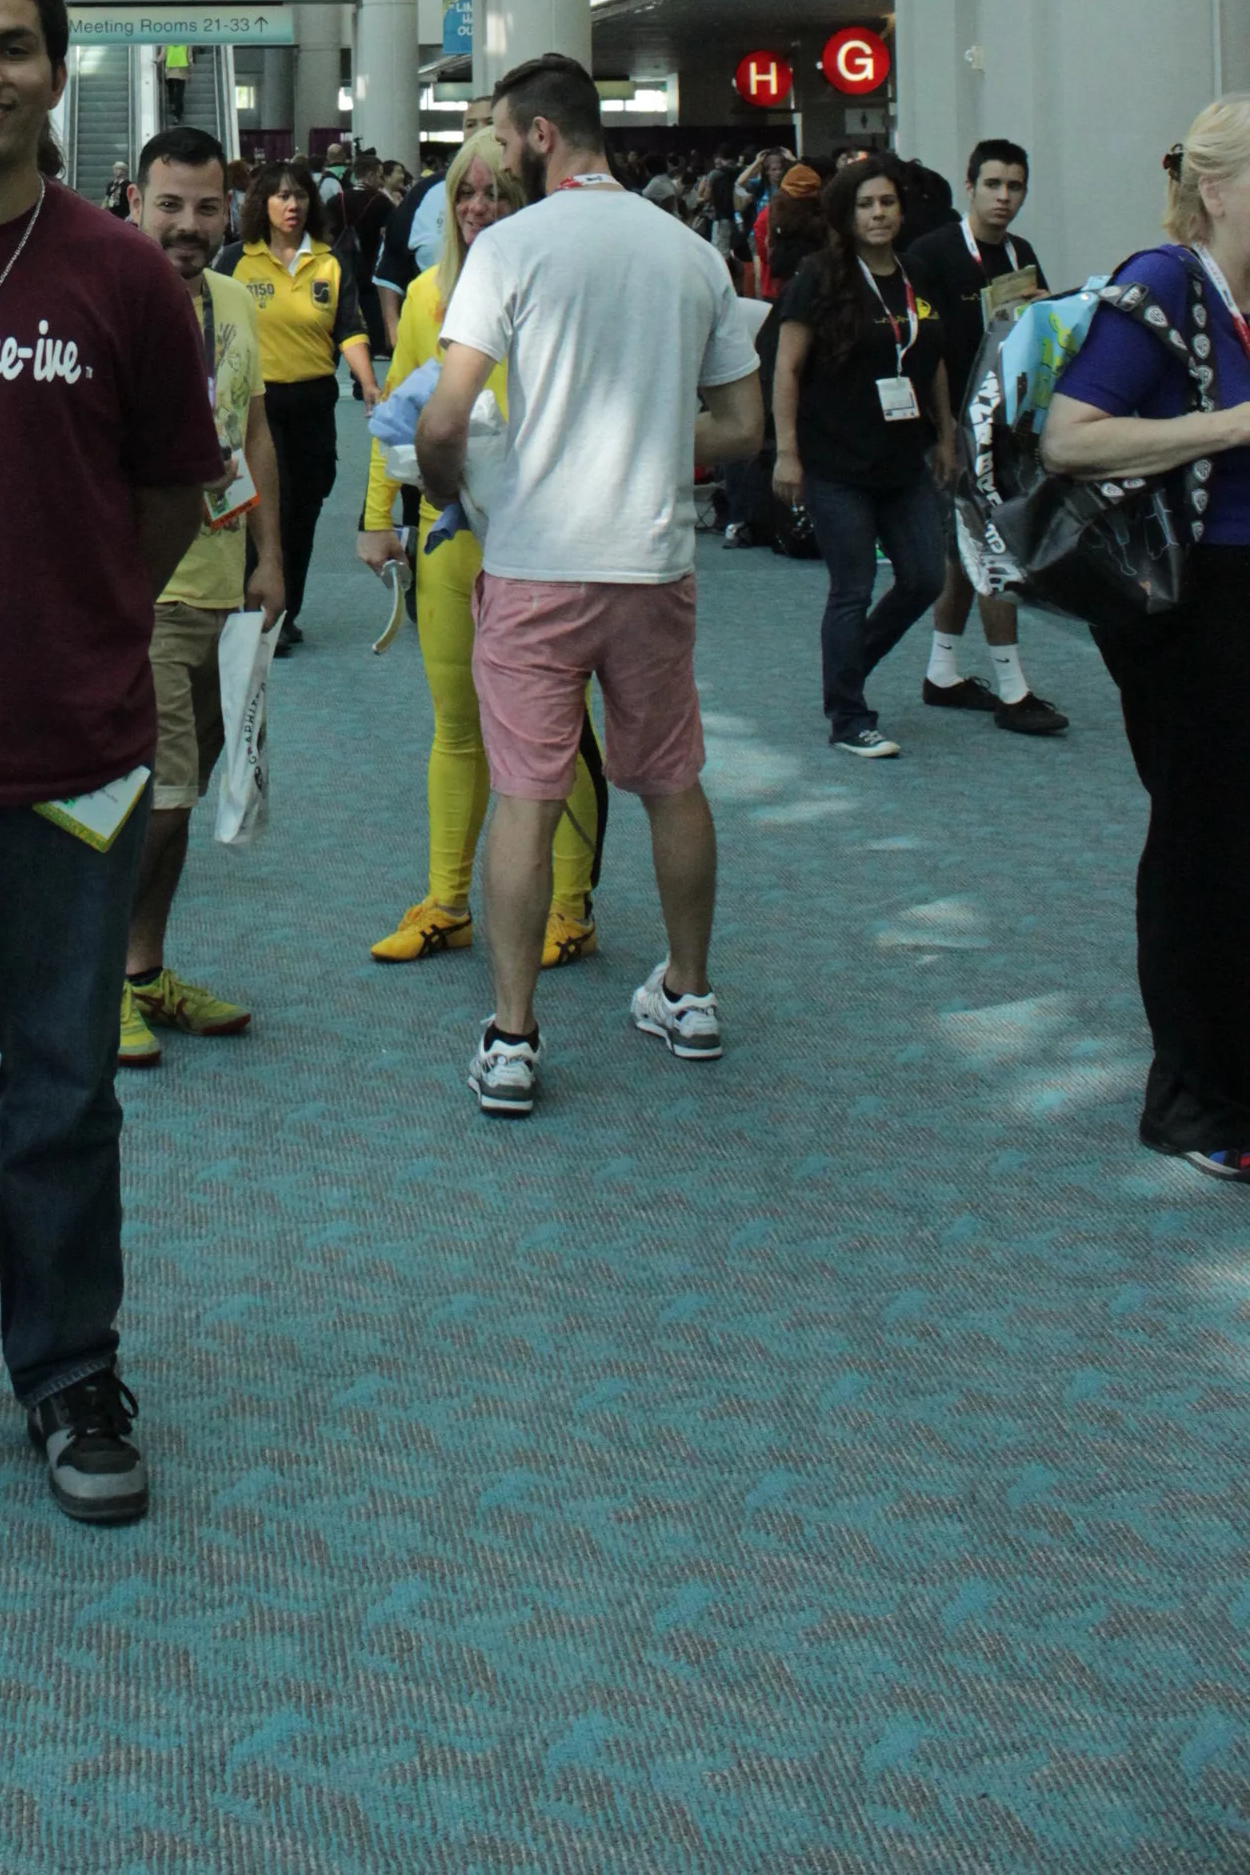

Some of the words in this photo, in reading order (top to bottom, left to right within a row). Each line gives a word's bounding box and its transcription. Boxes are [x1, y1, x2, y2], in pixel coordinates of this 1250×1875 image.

[70, 19, 134, 36] Meeting
[141, 18, 197, 33] Rooms
[203, 17, 250, 33] 21-33
[837, 40, 874, 81] G
[750, 61, 778, 95] H
